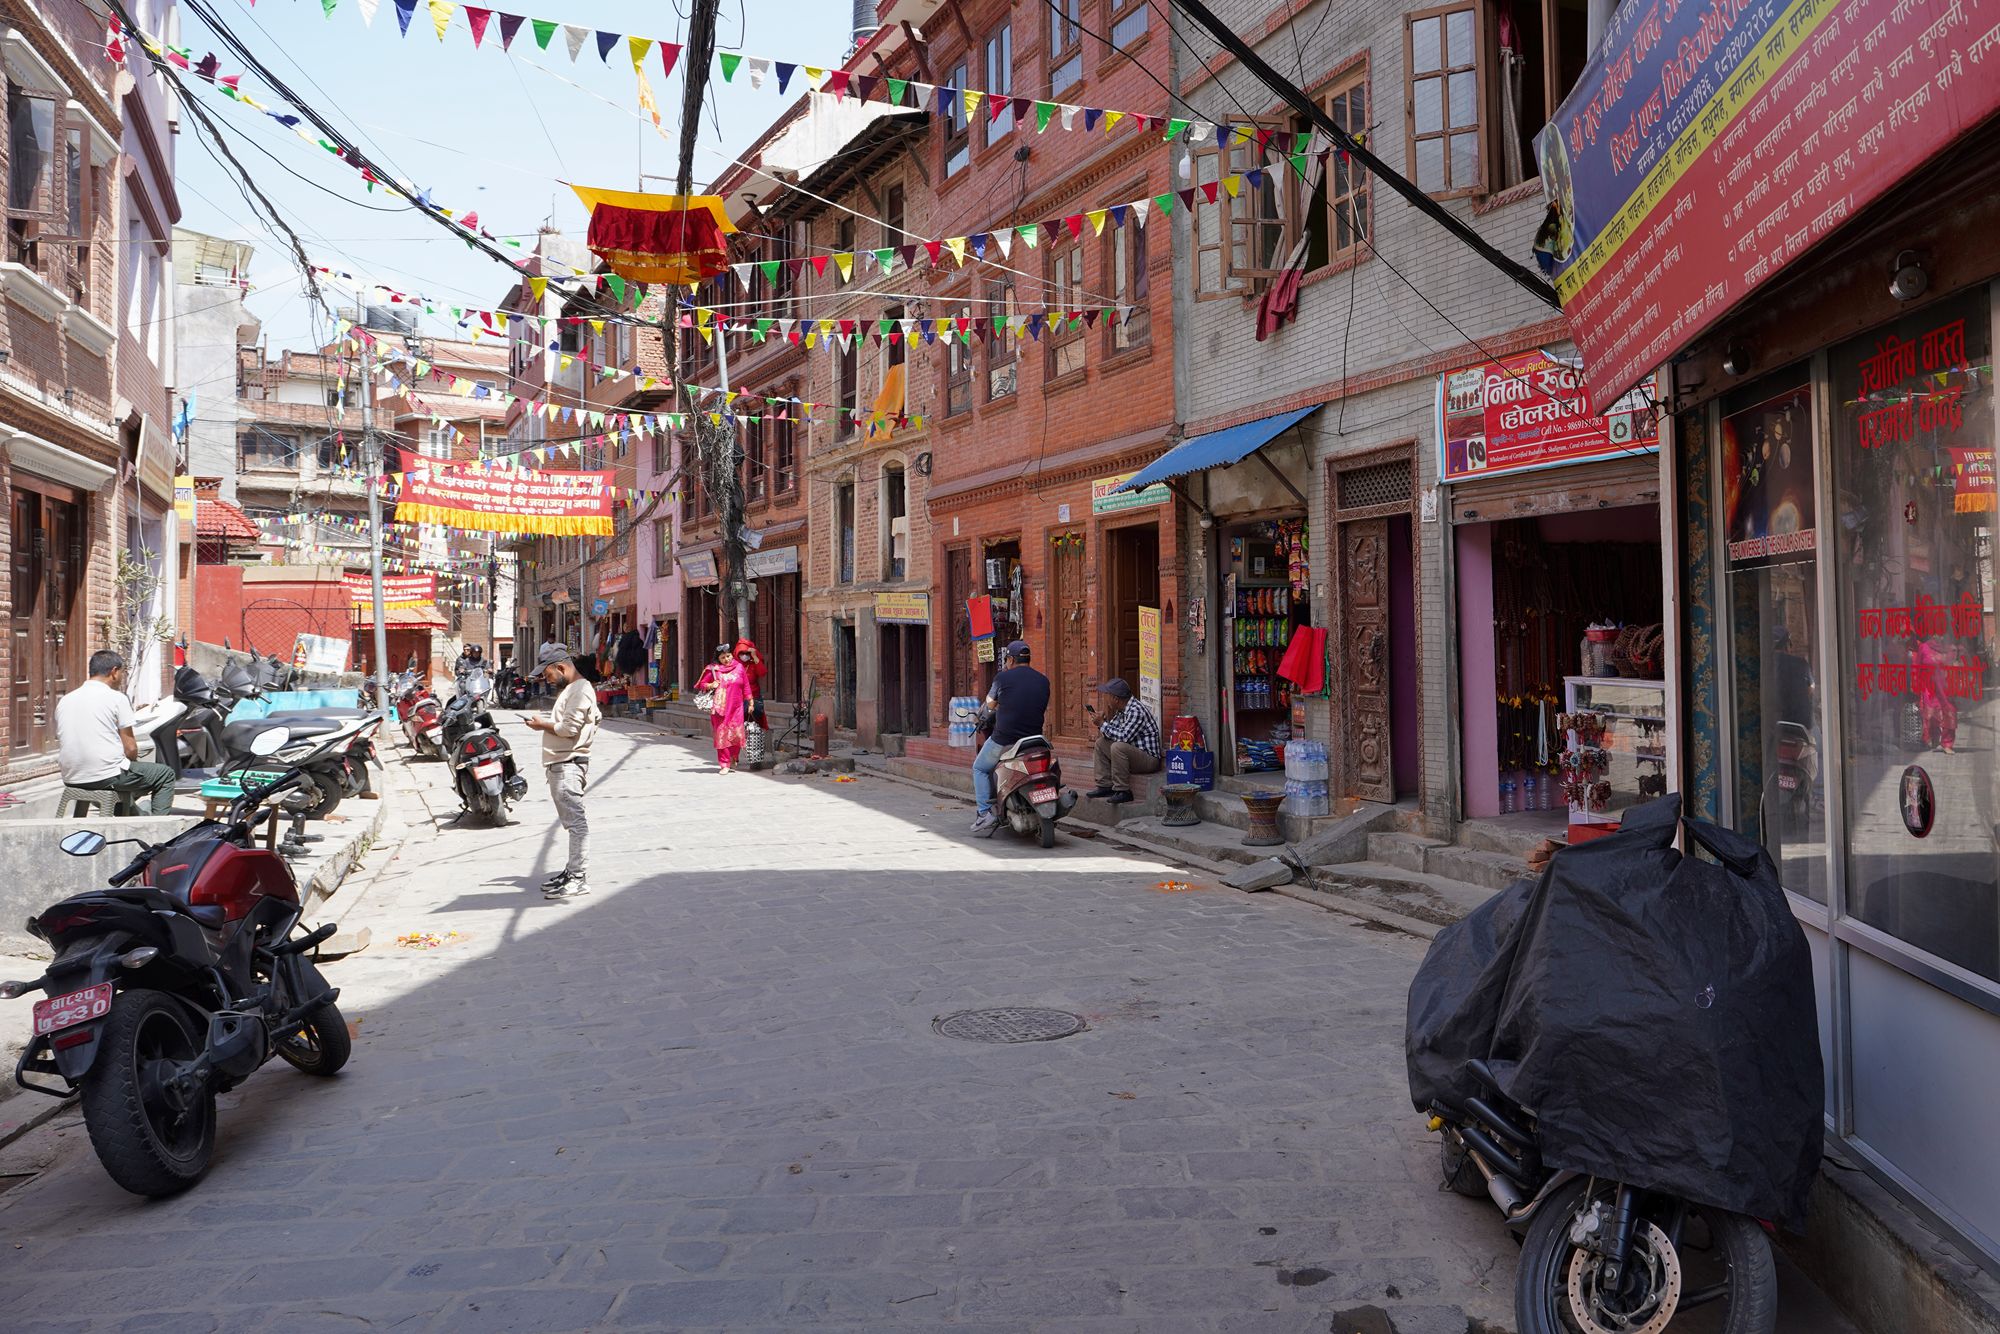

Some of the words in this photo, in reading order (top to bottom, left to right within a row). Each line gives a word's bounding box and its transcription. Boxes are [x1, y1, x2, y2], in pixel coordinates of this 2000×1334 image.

[1765, 27, 1786, 61] नसा
[1812, 15, 1841, 58] रोगको
[1863, 19, 1887, 53] काम
[1772, 148, 1801, 186] अनुसार
[1801, 130, 1820, 157] जाप
[1887, 44, 1914, 79] जन्म
[1791, 187, 1805, 209] घर
[1807, 161, 1831, 196] घडेरी
[1833, 148, 1856, 181] शुभ,
[1857, 120, 1885, 155] अशुभ
[1785, 225, 1809, 257] मिलन
[1503, 368, 1526, 379] Nima
[1858, 335, 1917, 399] ज्योतिष
[1921, 319, 1968, 373] वास्तु
[1484, 374, 1533, 408] निमा
[1859, 388, 1915, 449] परामर्श
[1919, 380, 1964, 433] केन्द्र
[1729, 542, 1739, 561] THE
[1739, 538, 1761, 560] UNIVERSE
[1766, 535, 1777, 556] THE
[1776, 532, 1795, 554] SOLAR
[1794, 528, 1816, 552] SYSTEM
[1877, 654, 1907, 697] मोहन
